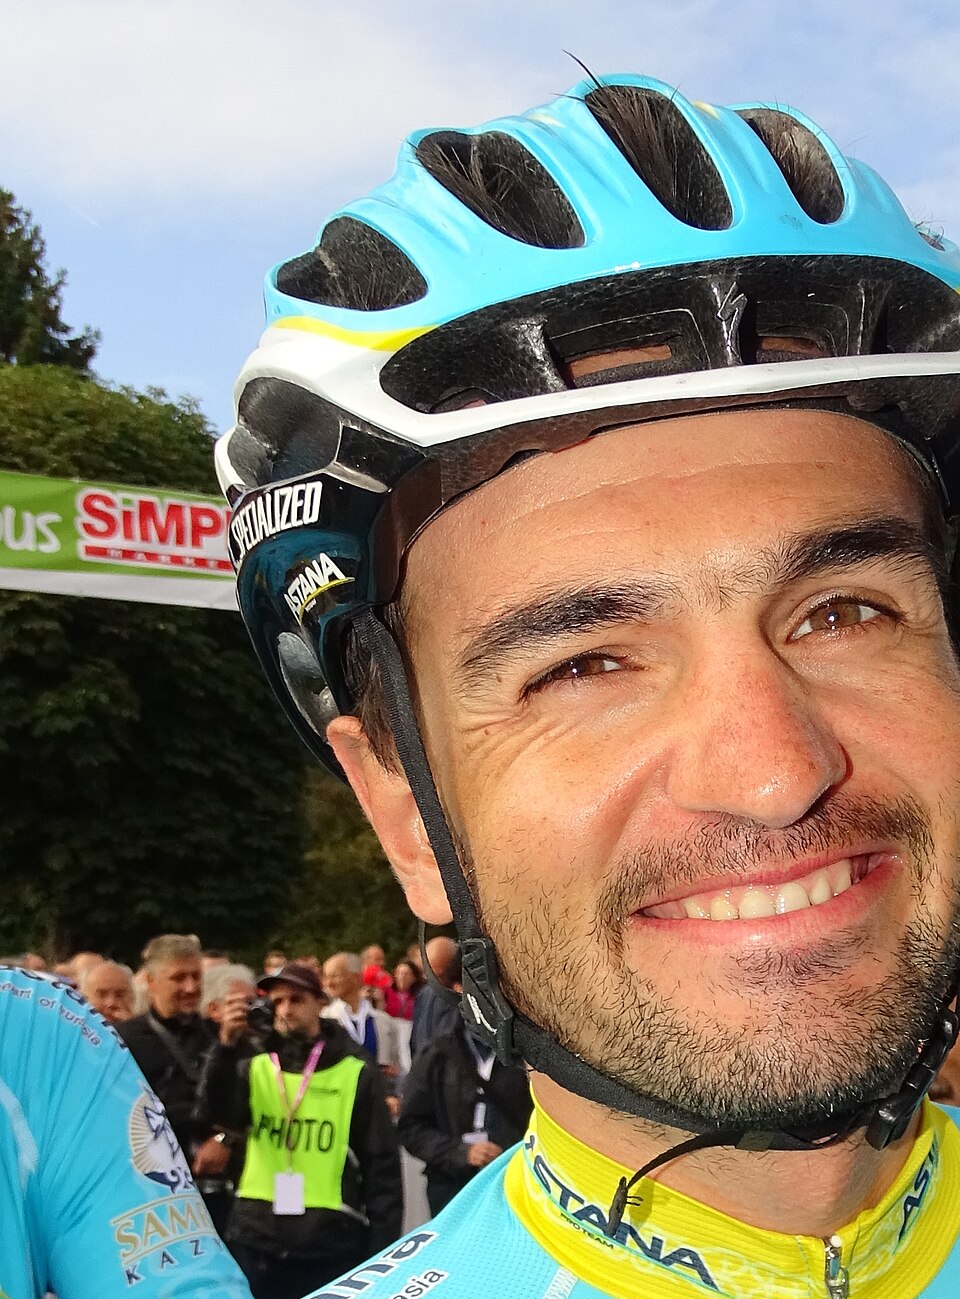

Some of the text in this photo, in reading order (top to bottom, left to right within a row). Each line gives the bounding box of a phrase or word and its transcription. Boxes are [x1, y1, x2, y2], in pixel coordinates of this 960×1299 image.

[0, 505, 62, 553] us
[231, 481, 323, 561] SPECIALIZED
[283, 553, 346, 625] ASTANA
[254, 1113, 334, 1153] PHOTO
